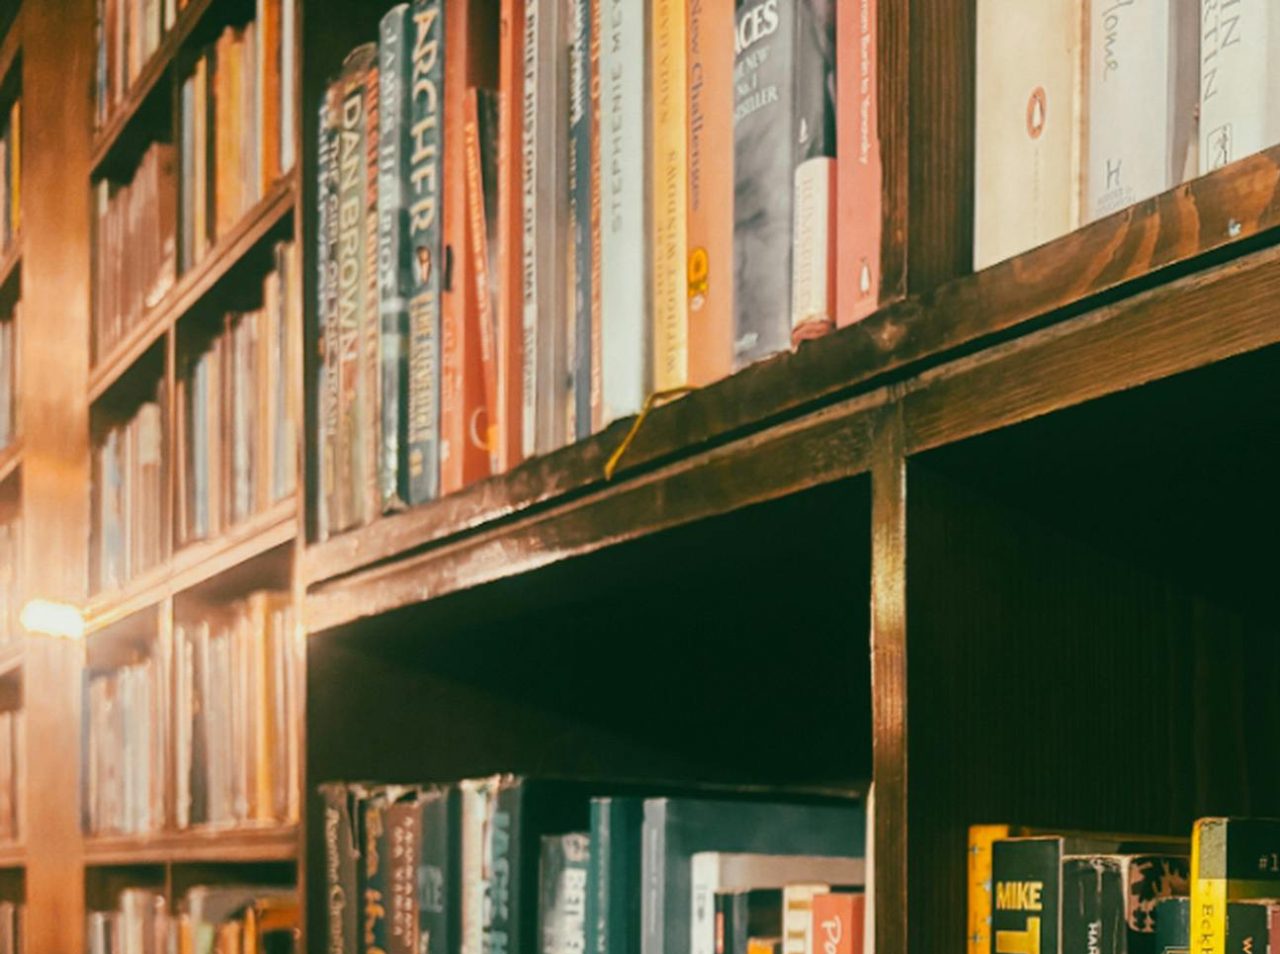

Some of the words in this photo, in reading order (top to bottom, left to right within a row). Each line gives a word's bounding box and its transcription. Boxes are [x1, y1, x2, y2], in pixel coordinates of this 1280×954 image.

[342, 95, 363, 194] DAN
[410, 7, 438, 238] ARCHER
[340, 197, 361, 363] BROWN
[996, 881, 1043, 912] MIKE
[1257, 855, 1280, 872] #1
